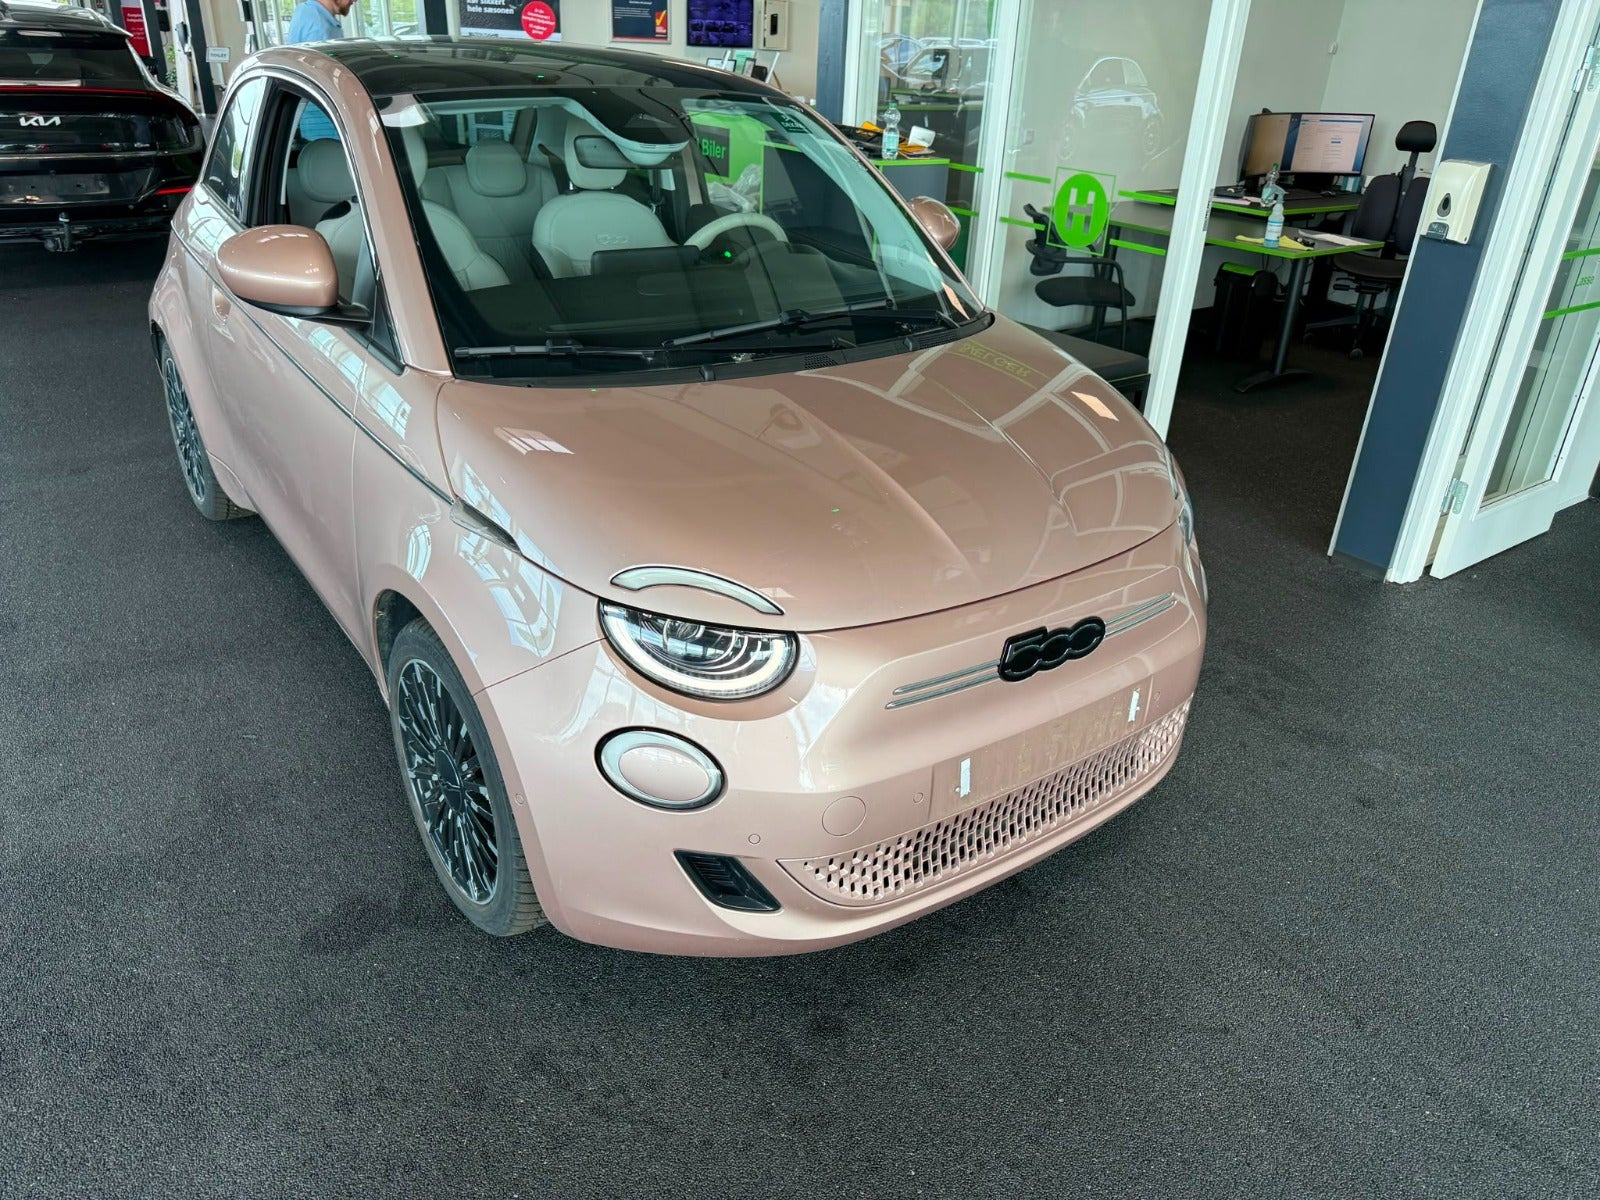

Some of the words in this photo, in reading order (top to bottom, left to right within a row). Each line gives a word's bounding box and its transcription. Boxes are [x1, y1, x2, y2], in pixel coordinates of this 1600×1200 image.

[466, 4, 482, 13] hele
[483, 7, 515, 15] sæsonen
[19, 115, 62, 127] KIA
[702, 138, 726, 159] Biler
[998, 615, 1106, 682] 500
